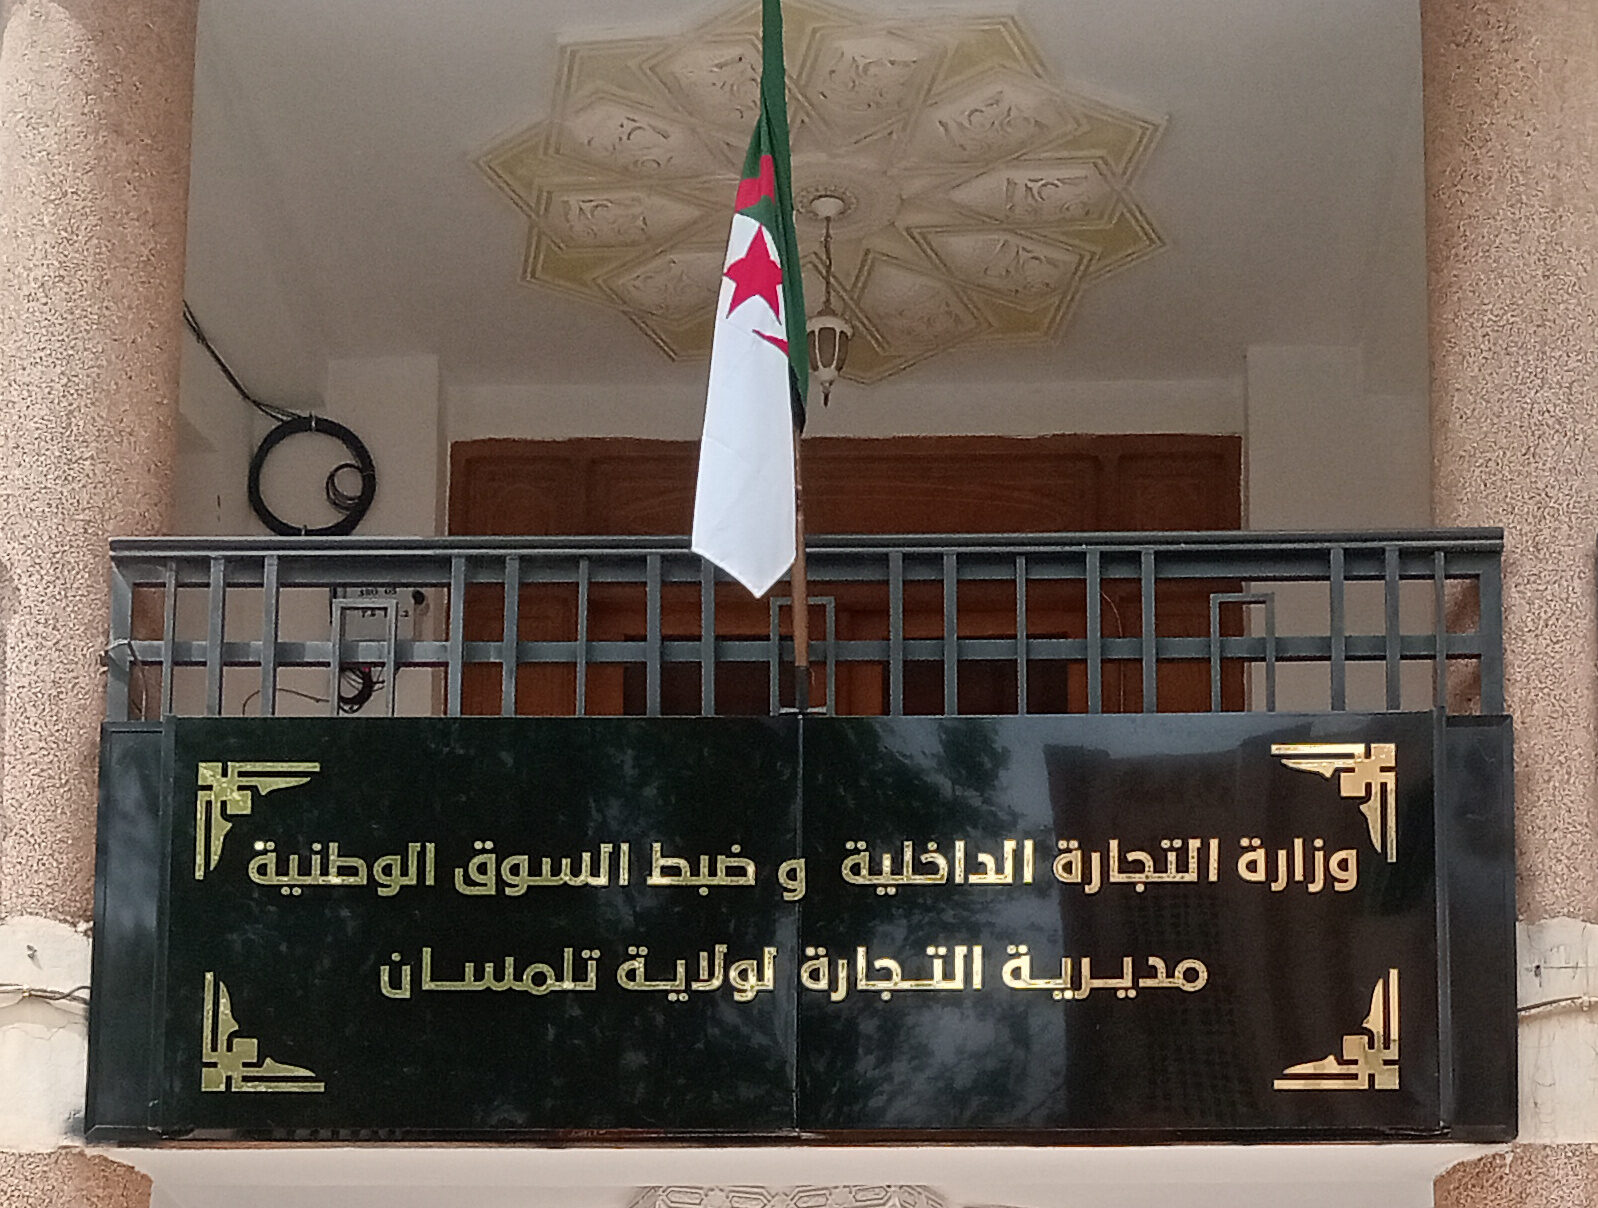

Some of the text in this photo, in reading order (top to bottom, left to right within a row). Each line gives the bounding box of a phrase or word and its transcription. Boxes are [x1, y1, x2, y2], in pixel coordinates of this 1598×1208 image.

[248, 837, 1359, 901] وزارة التجارة الداخلية و ضبط السوق الوطنية
[379, 944, 1209, 1002] مديرية التجارة لولاية تلمسان
